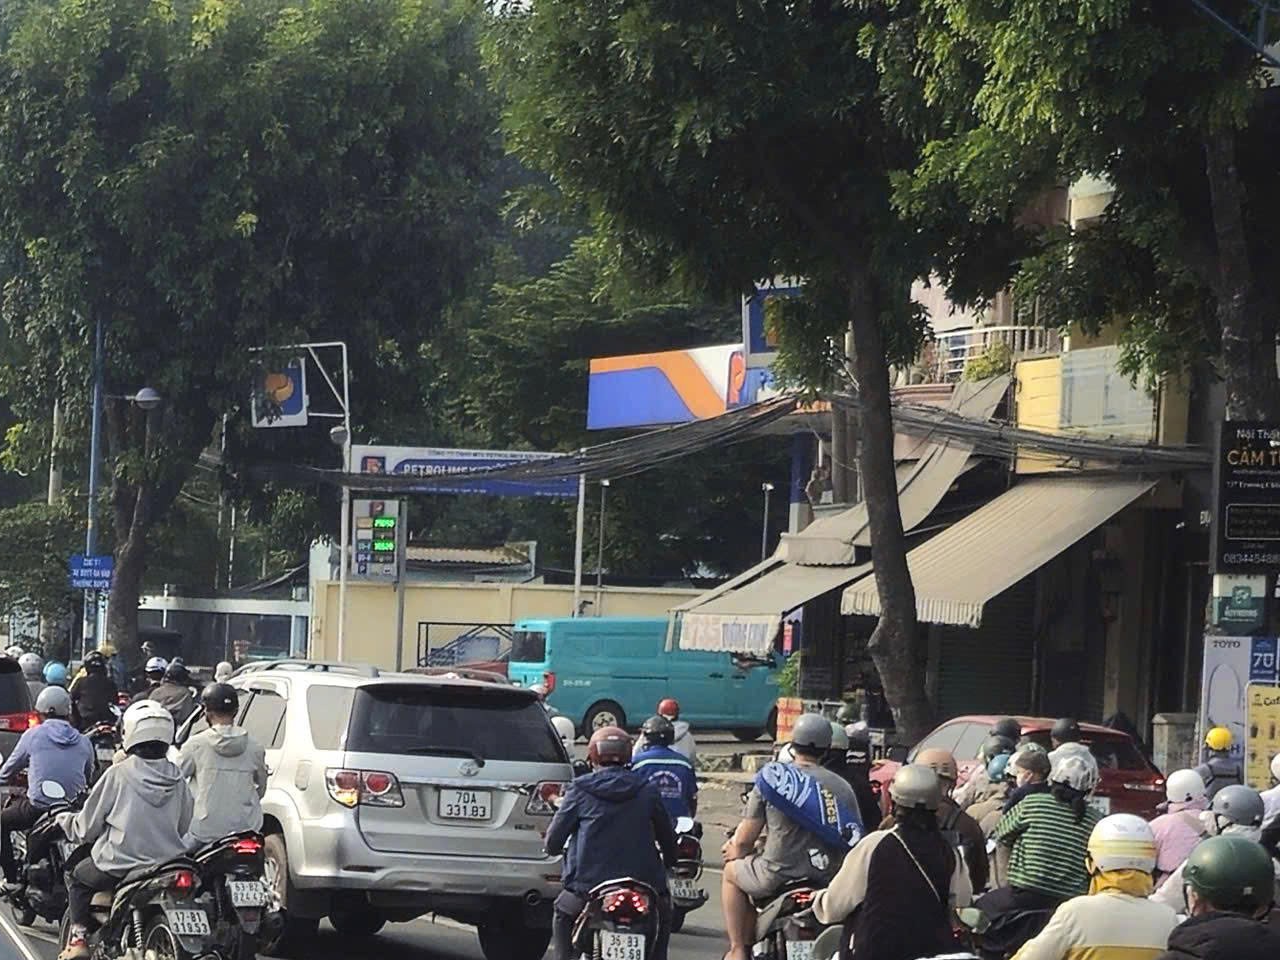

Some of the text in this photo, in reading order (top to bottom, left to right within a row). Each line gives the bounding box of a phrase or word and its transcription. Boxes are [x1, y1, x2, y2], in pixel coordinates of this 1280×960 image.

[1213, 641, 1241, 649] TOTO
[455, 791, 477, 804] 70A
[446, 804, 486, 817] 331.83
[175, 911, 201, 922] 17-B1
